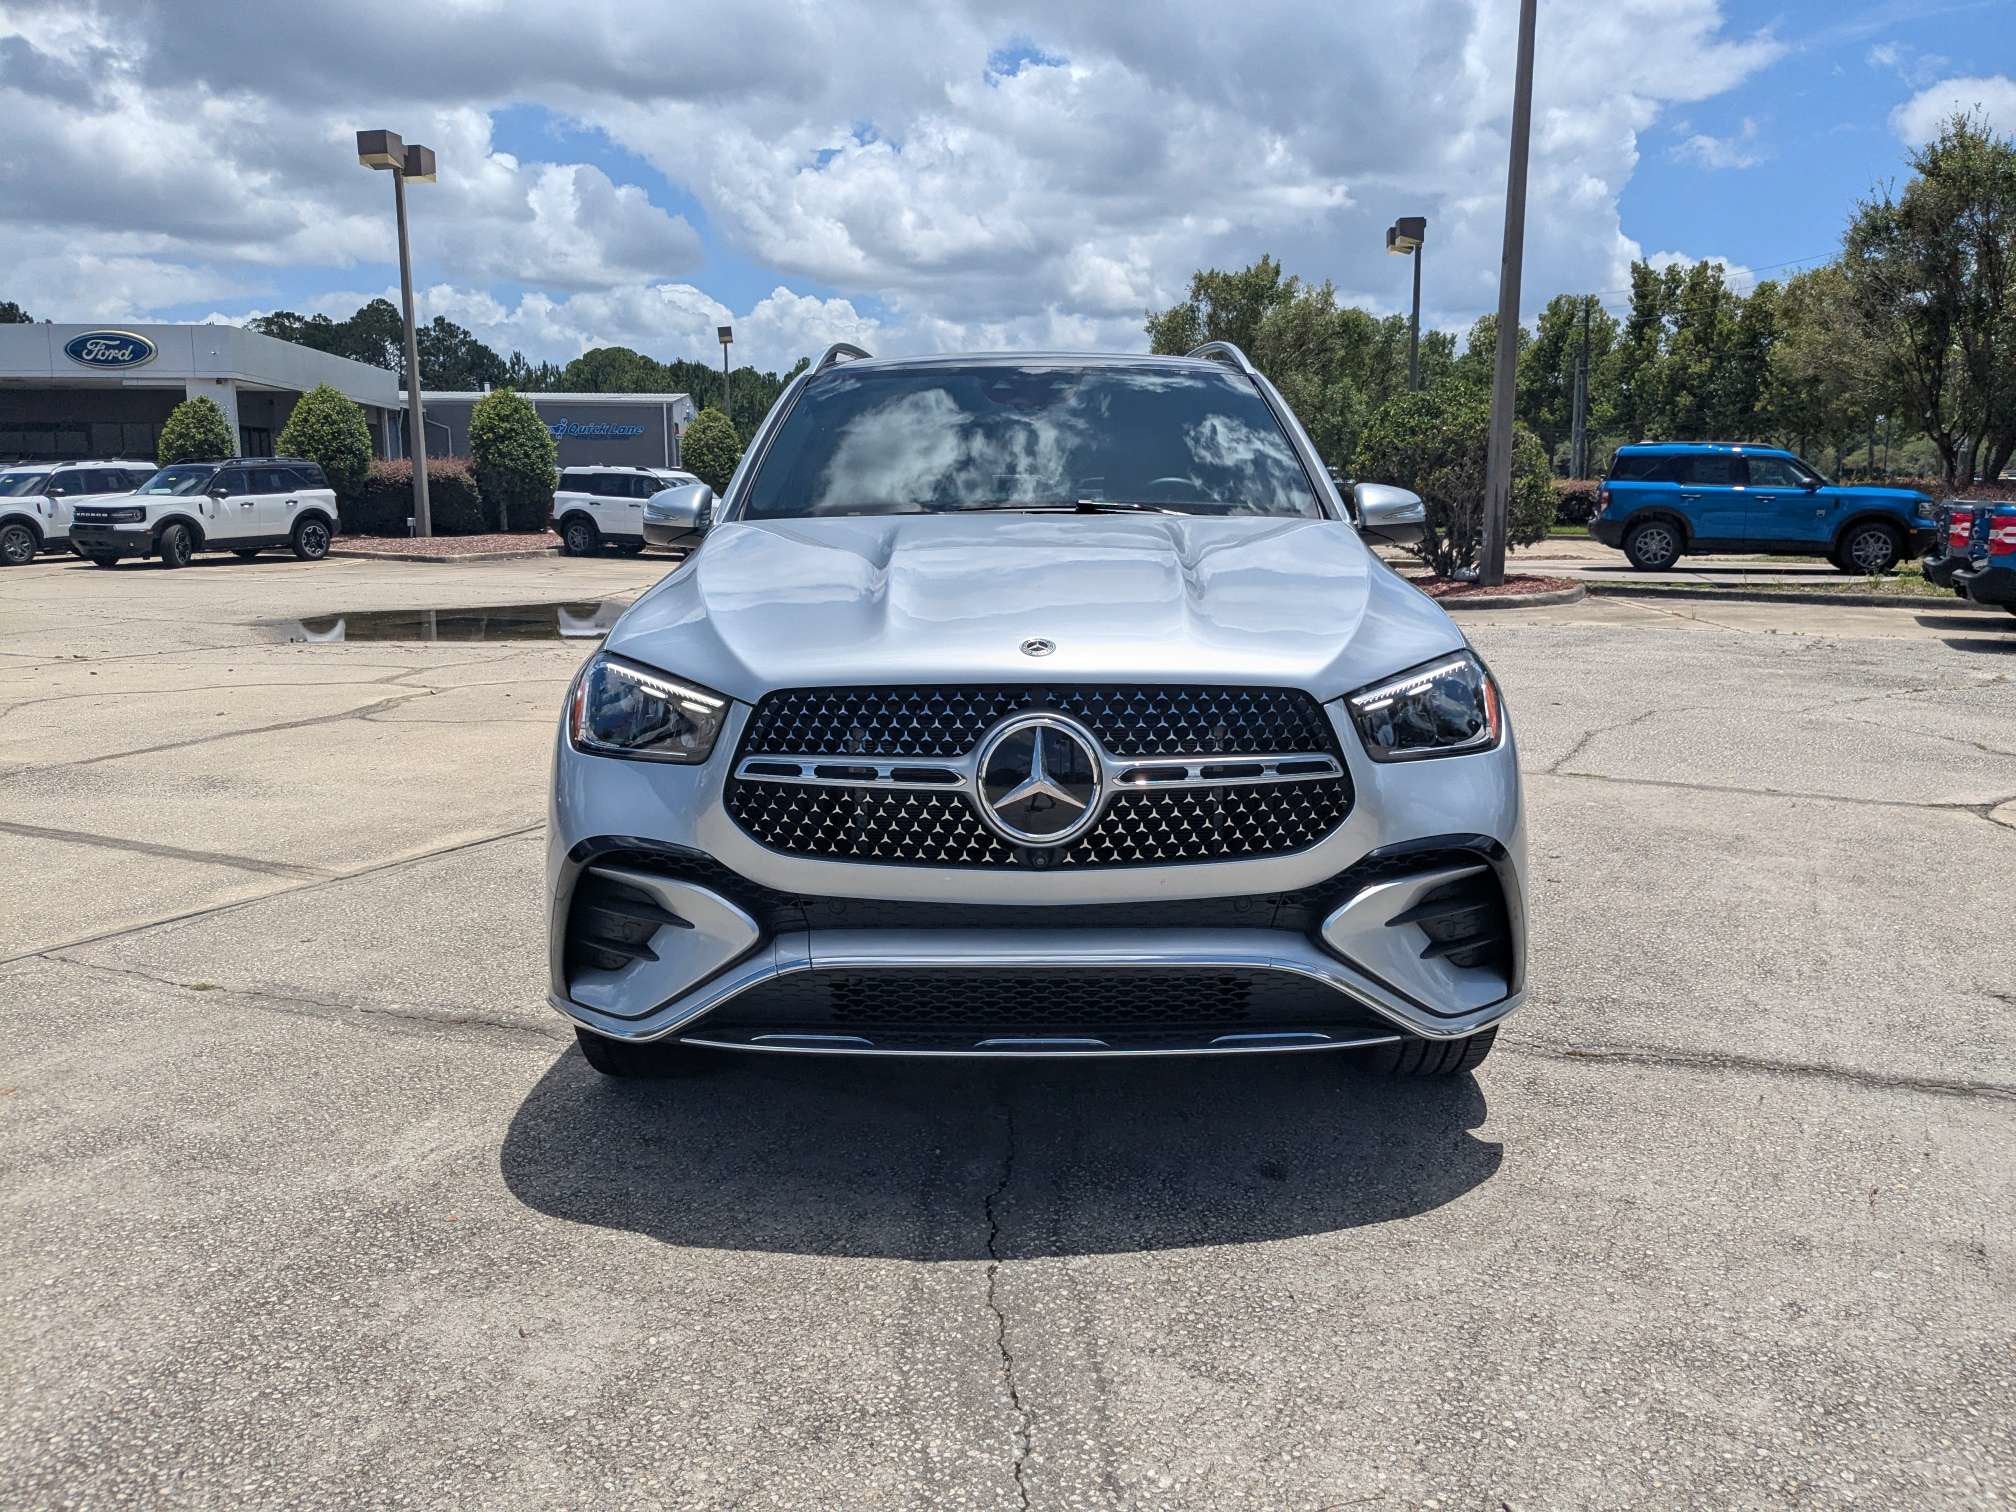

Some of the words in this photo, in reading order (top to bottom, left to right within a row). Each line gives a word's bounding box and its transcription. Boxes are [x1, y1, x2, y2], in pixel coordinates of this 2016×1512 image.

[82, 339, 133, 360] Ford
[568, 423, 609, 436] Quick
[610, 423, 645, 435] Lane
